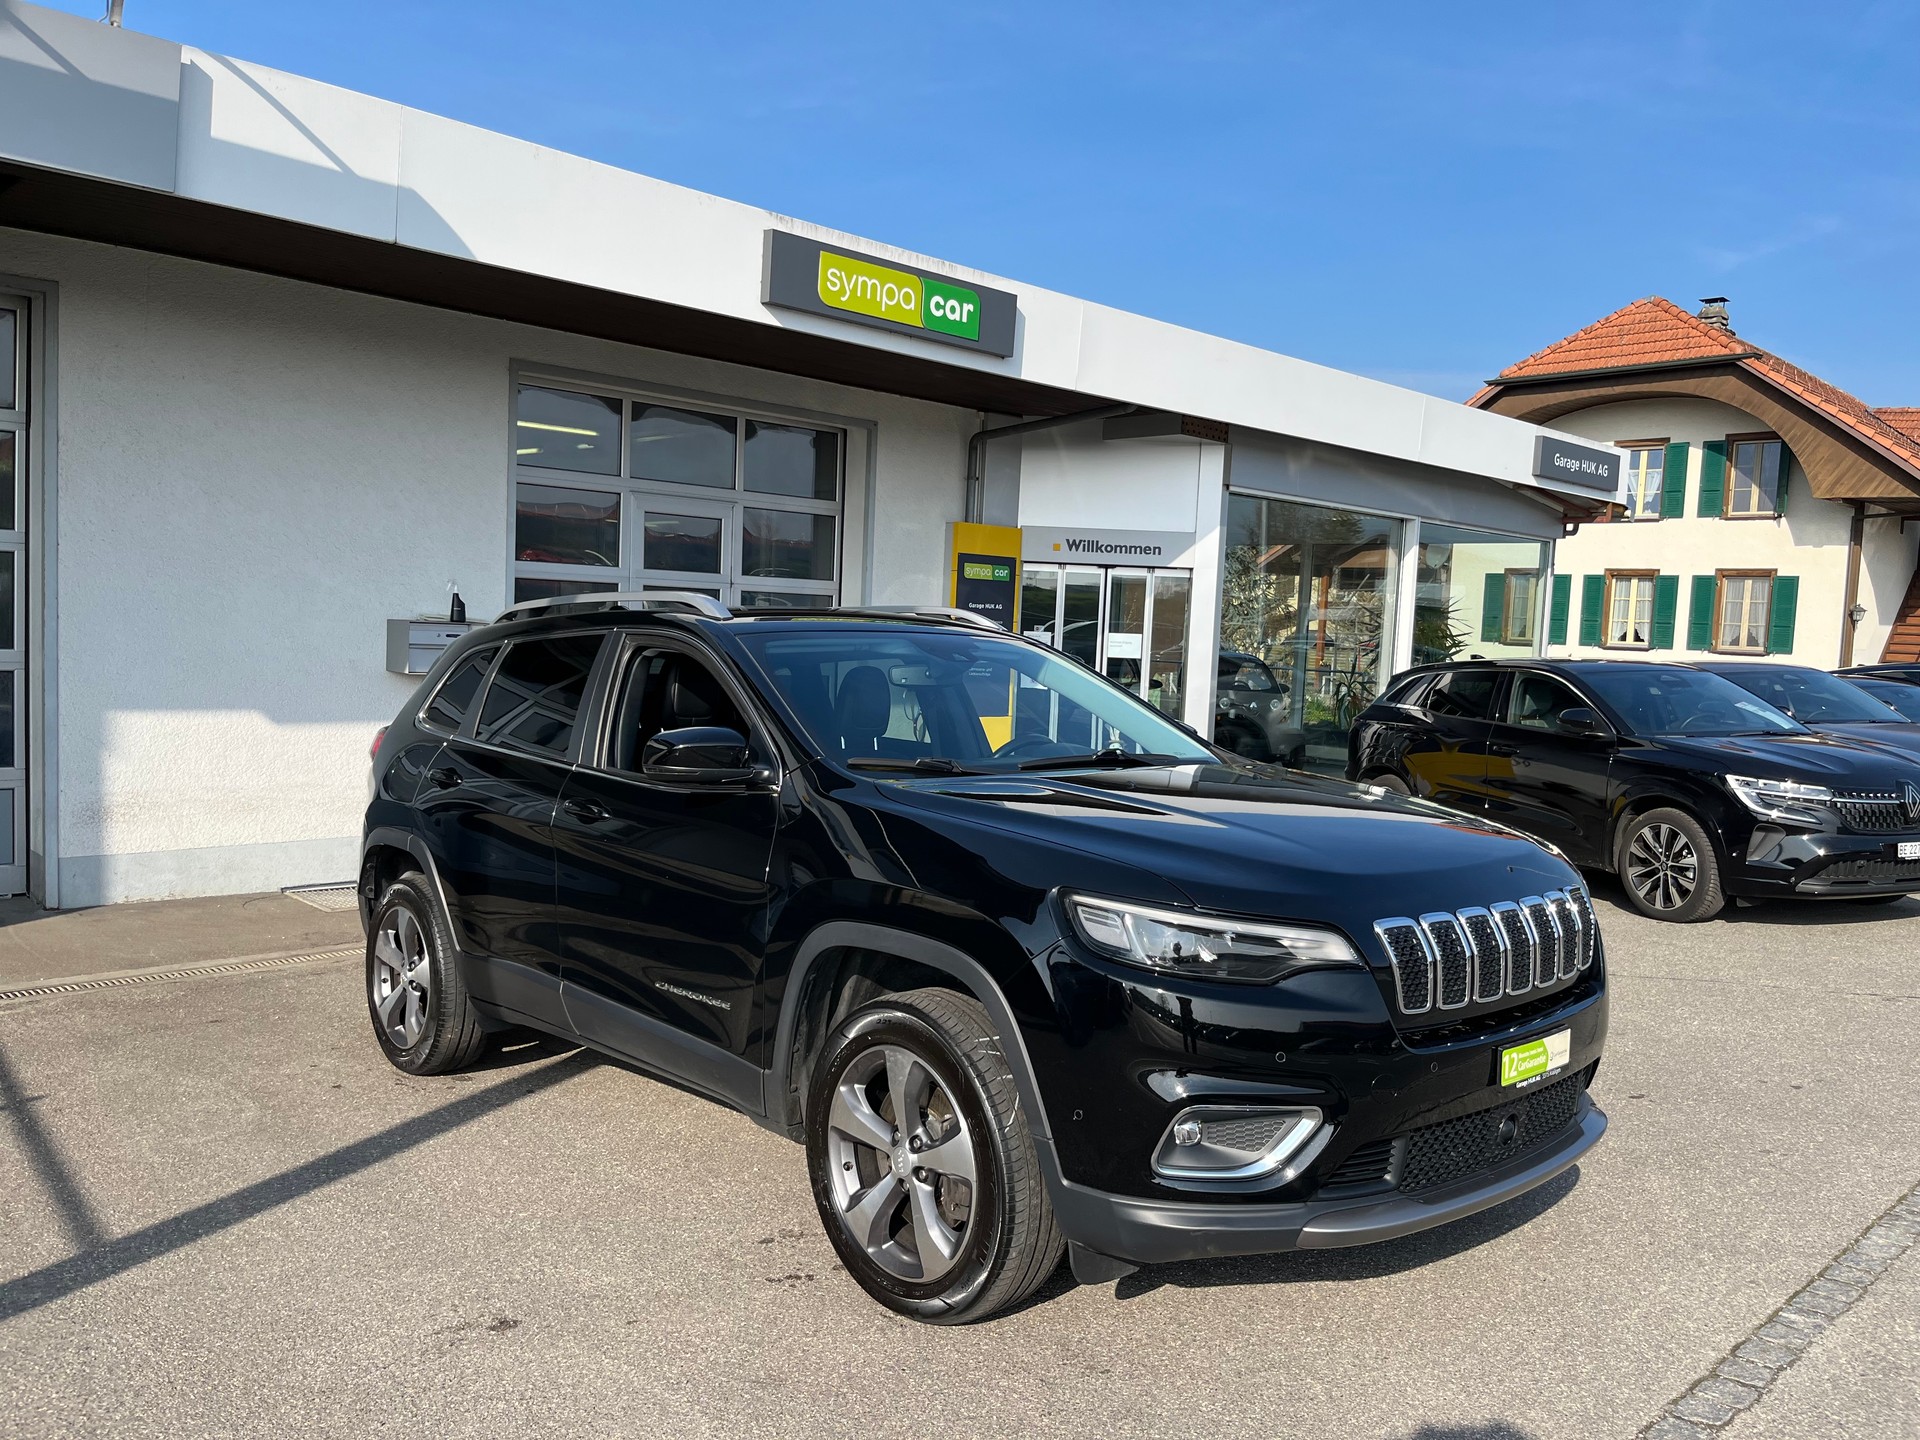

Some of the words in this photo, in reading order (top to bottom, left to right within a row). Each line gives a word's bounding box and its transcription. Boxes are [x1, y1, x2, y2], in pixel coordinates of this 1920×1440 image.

[826, 268, 915, 312] sympa
[930, 295, 974, 323] car
[1554, 453, 1580, 472] Garage
[1581, 459, 1597, 475] HUK
[1597, 464, 1608, 477] AG
[1065, 538, 1162, 556] Willkommen
[965, 566, 991, 578] sympa
[994, 569, 1008, 577] car
[968, 602, 985, 610] Garage
[1900, 844, 1908, 855] BE
[1503, 1052, 1518, 1080] 12
[1518, 1053, 1547, 1071] CarGarantie
